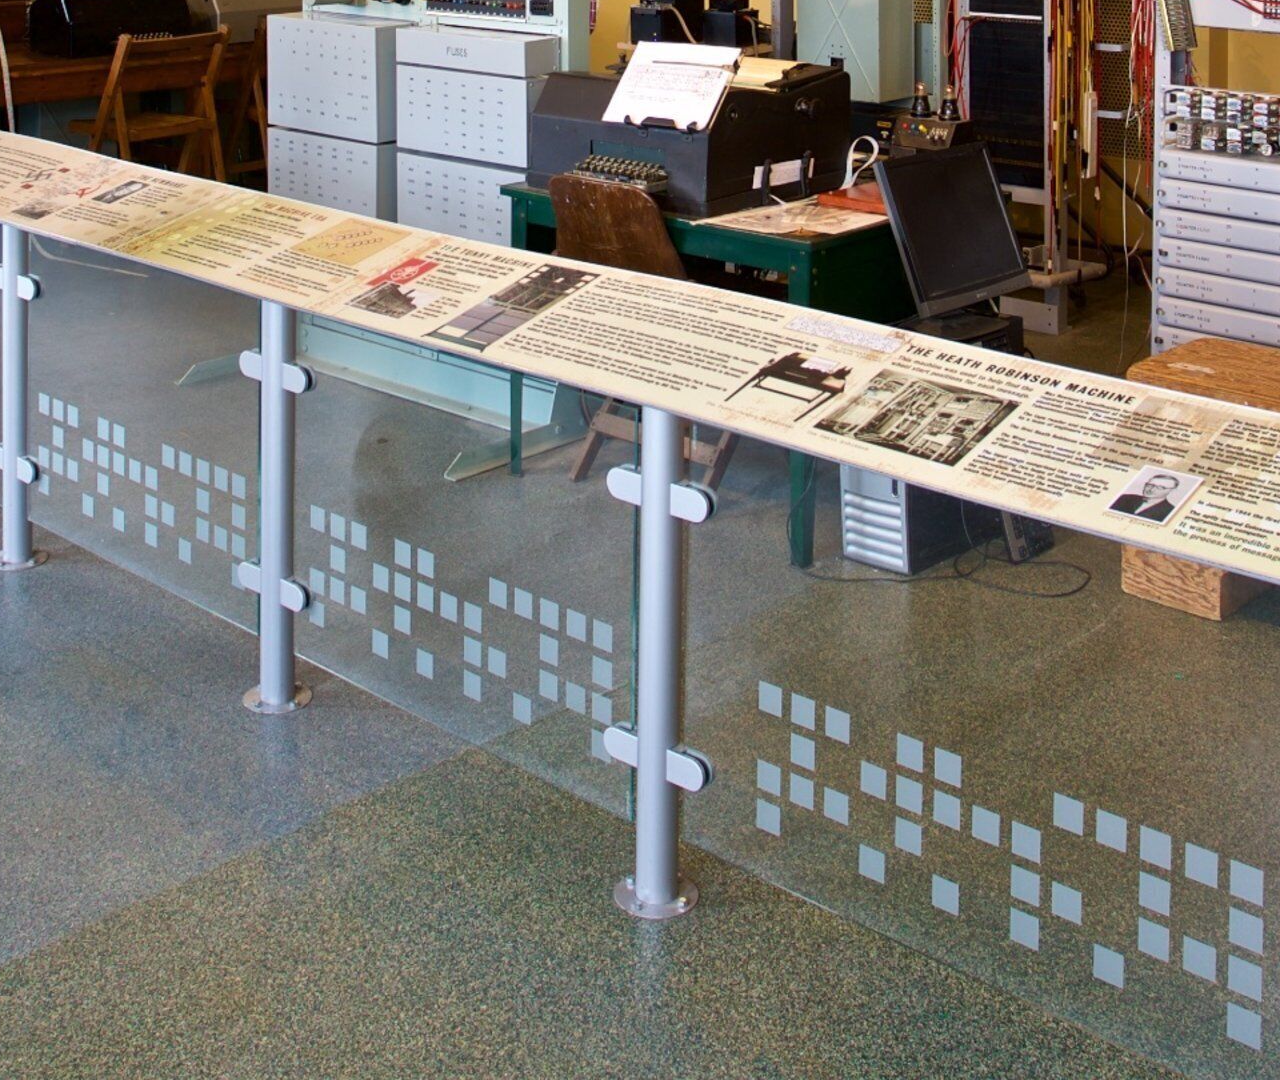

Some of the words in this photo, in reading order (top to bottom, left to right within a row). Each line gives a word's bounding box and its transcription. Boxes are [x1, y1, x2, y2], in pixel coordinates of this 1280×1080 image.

[446, 46, 468, 58] FUSES
[906, 344, 934, 358] THE
[936, 352, 982, 369] HEATH
[985, 364, 1061, 388] ROBINSON
[1068, 383, 1135, 405] MACHINE
[1172, 528, 1188, 538] the
[1188, 534, 1227, 547] process
[1178, 520, 1188, 529] It
[1189, 524, 1207, 533] was
[1223, 532, 1271, 550] incredible
